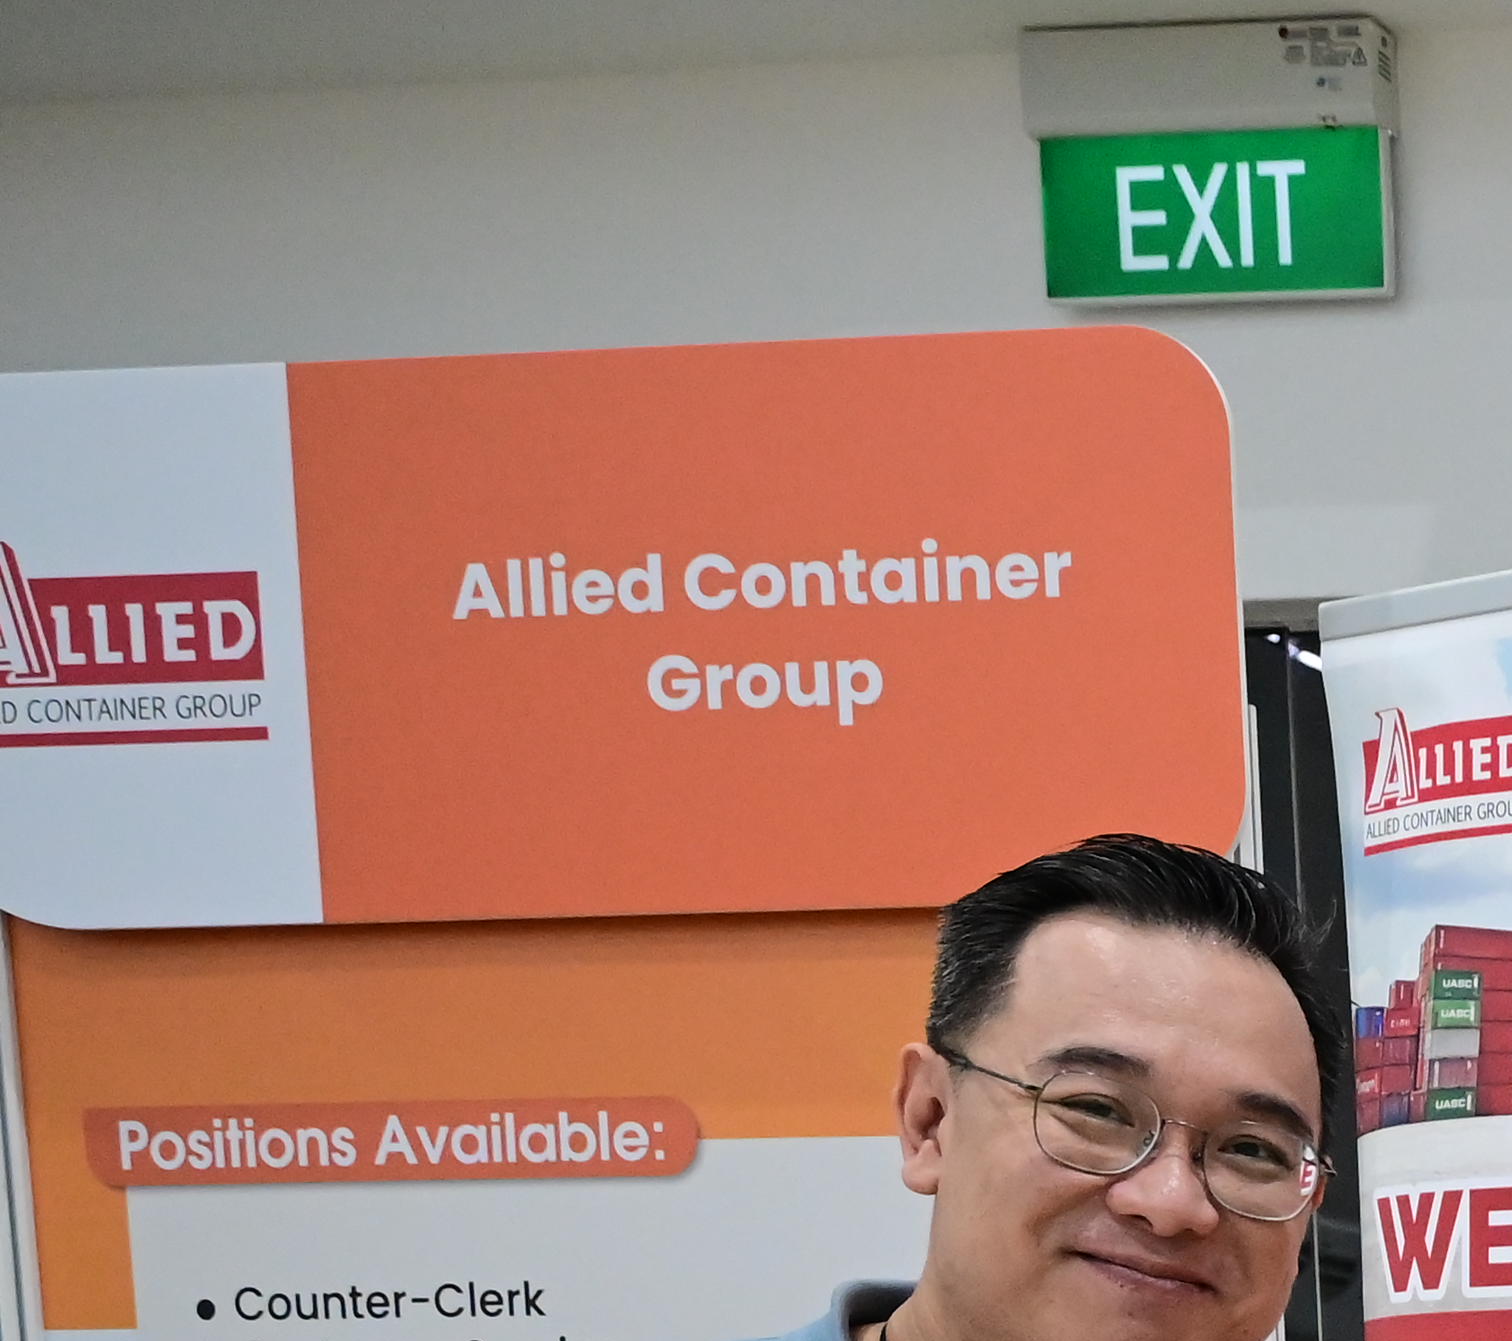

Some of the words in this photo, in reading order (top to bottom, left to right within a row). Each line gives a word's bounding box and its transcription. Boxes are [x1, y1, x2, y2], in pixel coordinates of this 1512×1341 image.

[1113, 158, 1306, 272] EXIT
[452, 550, 662, 620] Allied
[683, 537, 1072, 614] Container
[27, 694, 167, 724] CONTAINER
[175, 692, 262, 720] GROUP
[646, 653, 884, 726] Group
[1366, 816, 1400, 840] ALLIED
[1403, 804, 1473, 832] CONTAINER
[118, 1116, 357, 1172] Positions
[374, 1110, 667, 1168] Available:
[233, 1280, 547, 1322] Counter-Clerk
